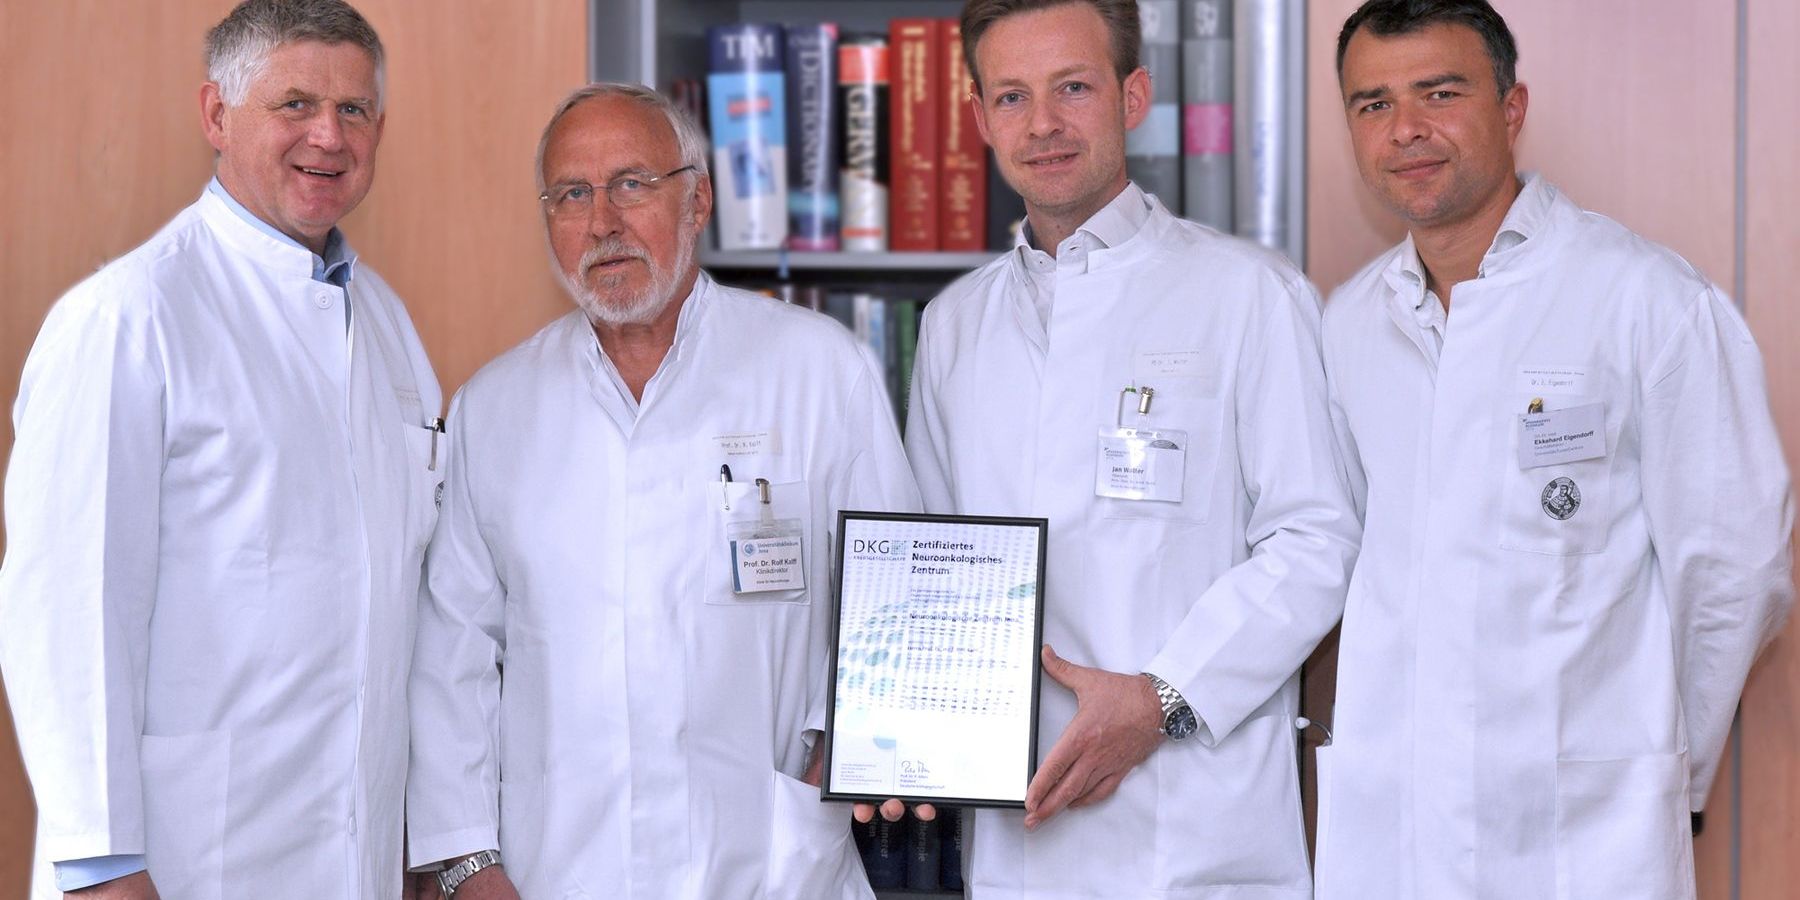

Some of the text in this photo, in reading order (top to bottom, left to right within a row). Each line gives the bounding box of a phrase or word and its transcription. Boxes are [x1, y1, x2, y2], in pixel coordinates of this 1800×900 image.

[1534, 436, 1563, 445] Ekkehard
[1563, 430, 1594, 441] Eigendorff
[853, 539, 890, 554] DKG
[912, 540, 974, 551] Zertifiziertes
[743, 560, 760, 568] Prof.
[911, 552, 1003, 566] Neuroonkologisches
[756, 567, 788, 575] Klinikdirektor
[911, 565, 950, 575] Zentrum
